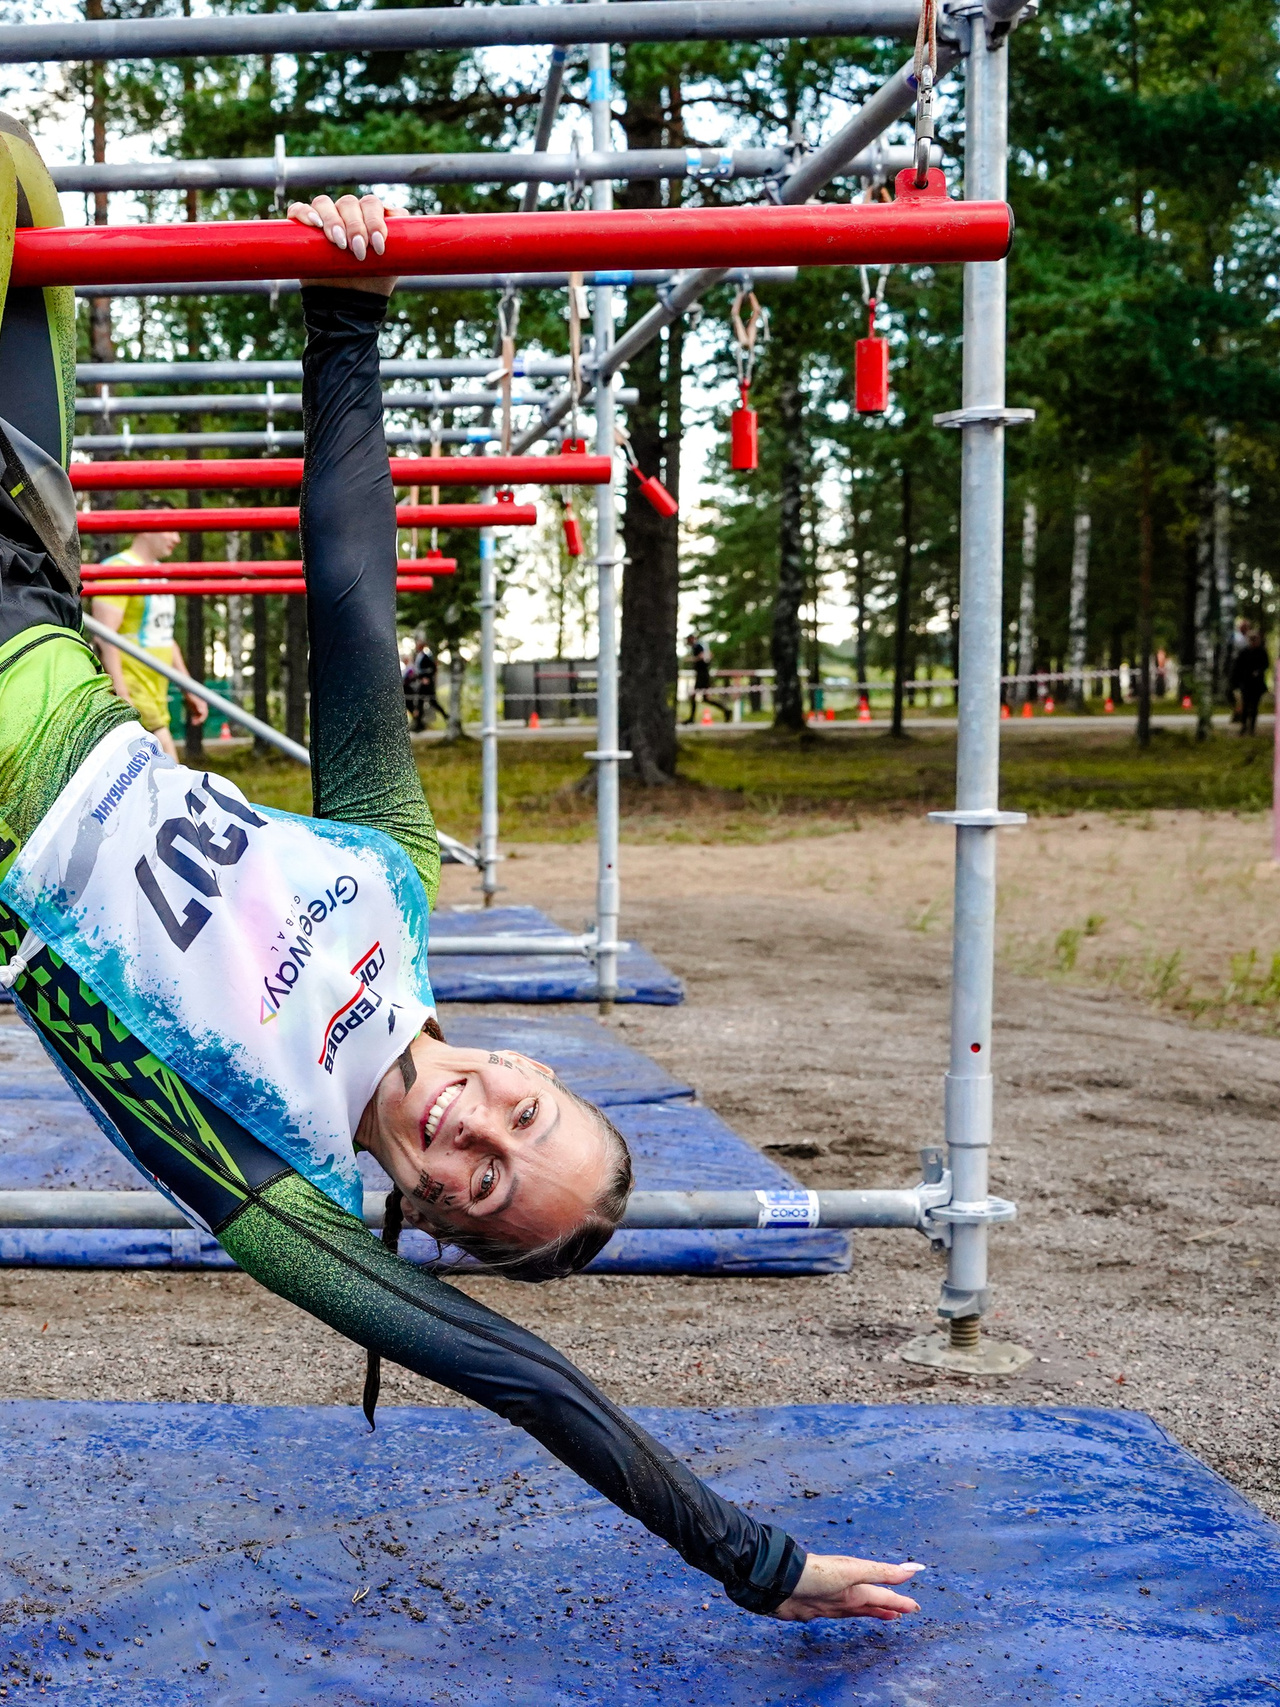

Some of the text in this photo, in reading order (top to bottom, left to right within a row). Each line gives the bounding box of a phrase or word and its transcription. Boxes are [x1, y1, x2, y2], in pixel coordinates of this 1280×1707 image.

[91, 749, 151, 826] ГАЗПРОМБАНК
[134, 773, 268, 952] 1307
[264, 875, 358, 1009] Greeway
[270, 895, 301, 952] GBAL
[324, 987, 382, 1075] ГЕРОЕВ
